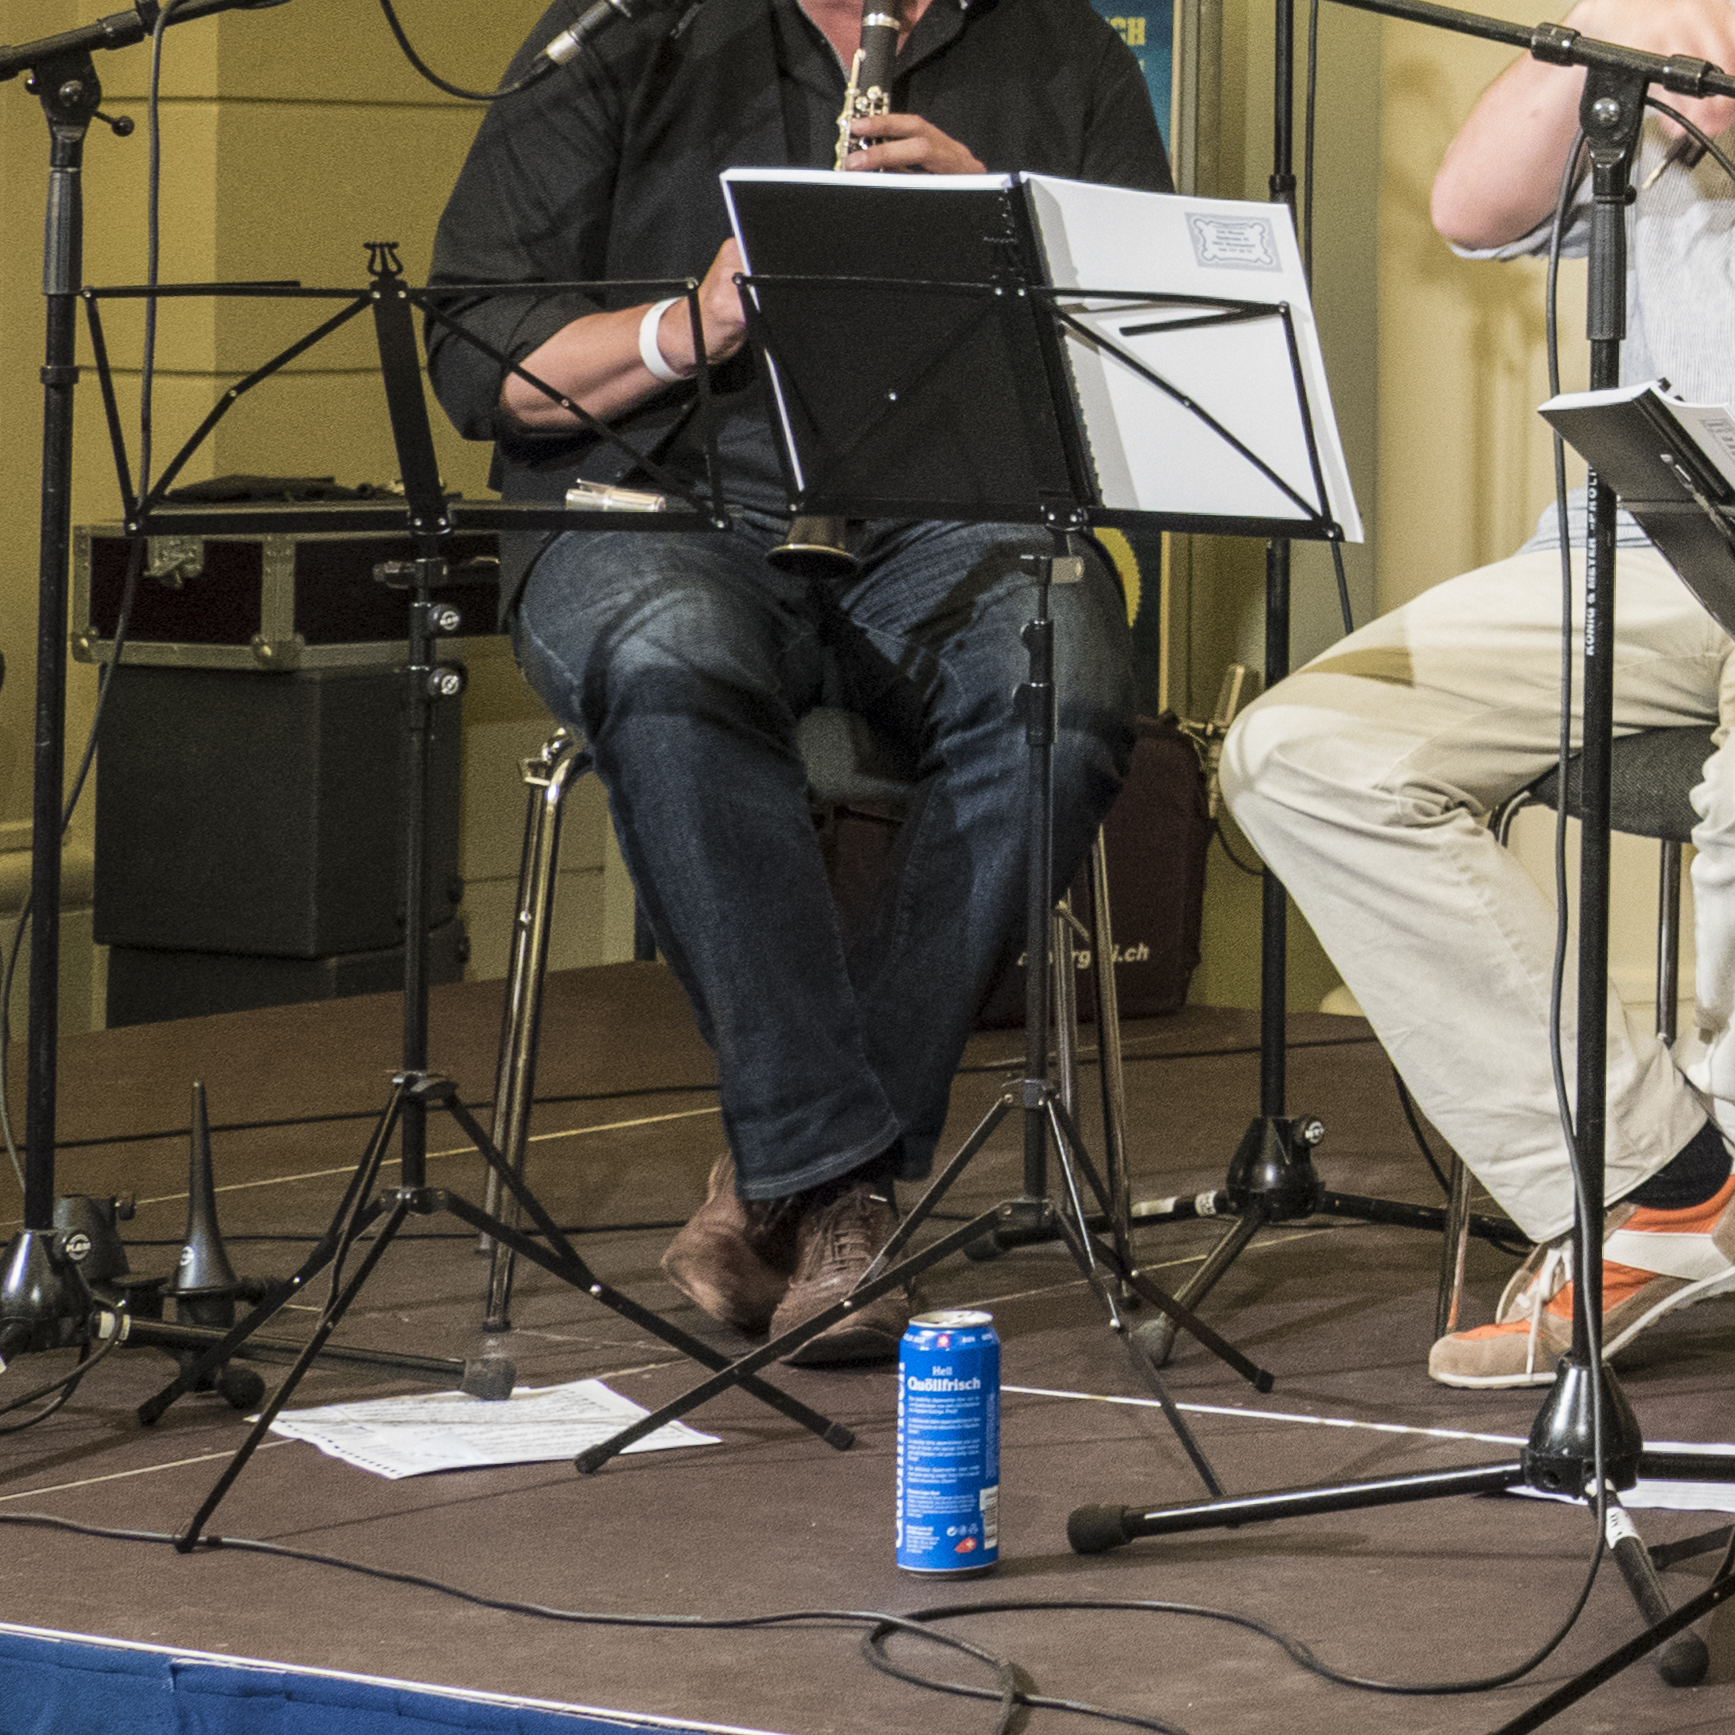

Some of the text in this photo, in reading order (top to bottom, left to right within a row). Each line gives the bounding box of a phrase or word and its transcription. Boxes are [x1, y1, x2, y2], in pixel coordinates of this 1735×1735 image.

[1587, 537, 1597, 589] MEYER
[932, 1365, 953, 1377] Hell
[907, 1375, 981, 1392] Quöllfrisch
